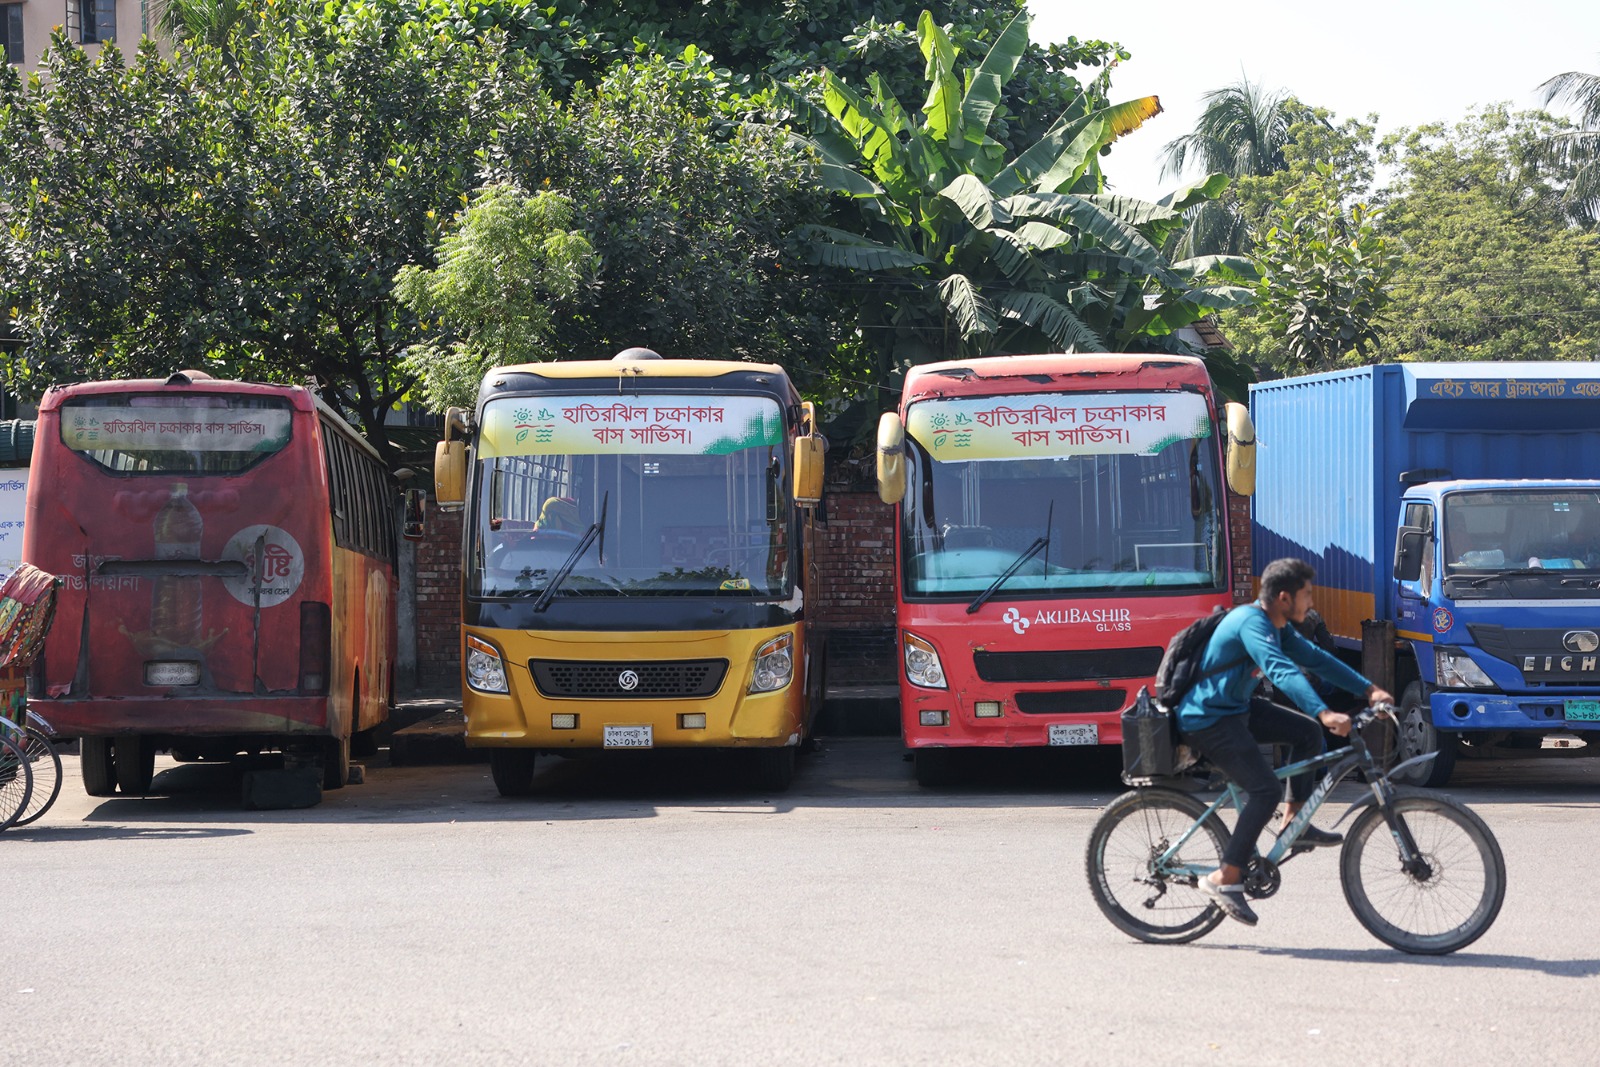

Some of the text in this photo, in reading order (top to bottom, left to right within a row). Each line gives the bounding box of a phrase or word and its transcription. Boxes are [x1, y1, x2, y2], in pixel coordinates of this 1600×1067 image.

[1470, 381, 1502, 399] আর
[562, 403, 725, 424] হাতিরঝিল চক্রাকার
[974, 403, 1167, 427] হাতিরঝিল চক্রাকার
[102, 419, 156, 435] হাতিরঝিল
[159, 420, 201, 435] চক্রাকার
[205, 422, 224, 435] বাস
[592, 424, 692, 445] বাস সার্ভিস।
[1012, 423, 1130, 448] বাস সার্ভিস।
[1095, 622, 1132, 632] GLASS
[1523, 656, 1597, 671] EICH
[1280, 772, 1334, 849] MARINE
